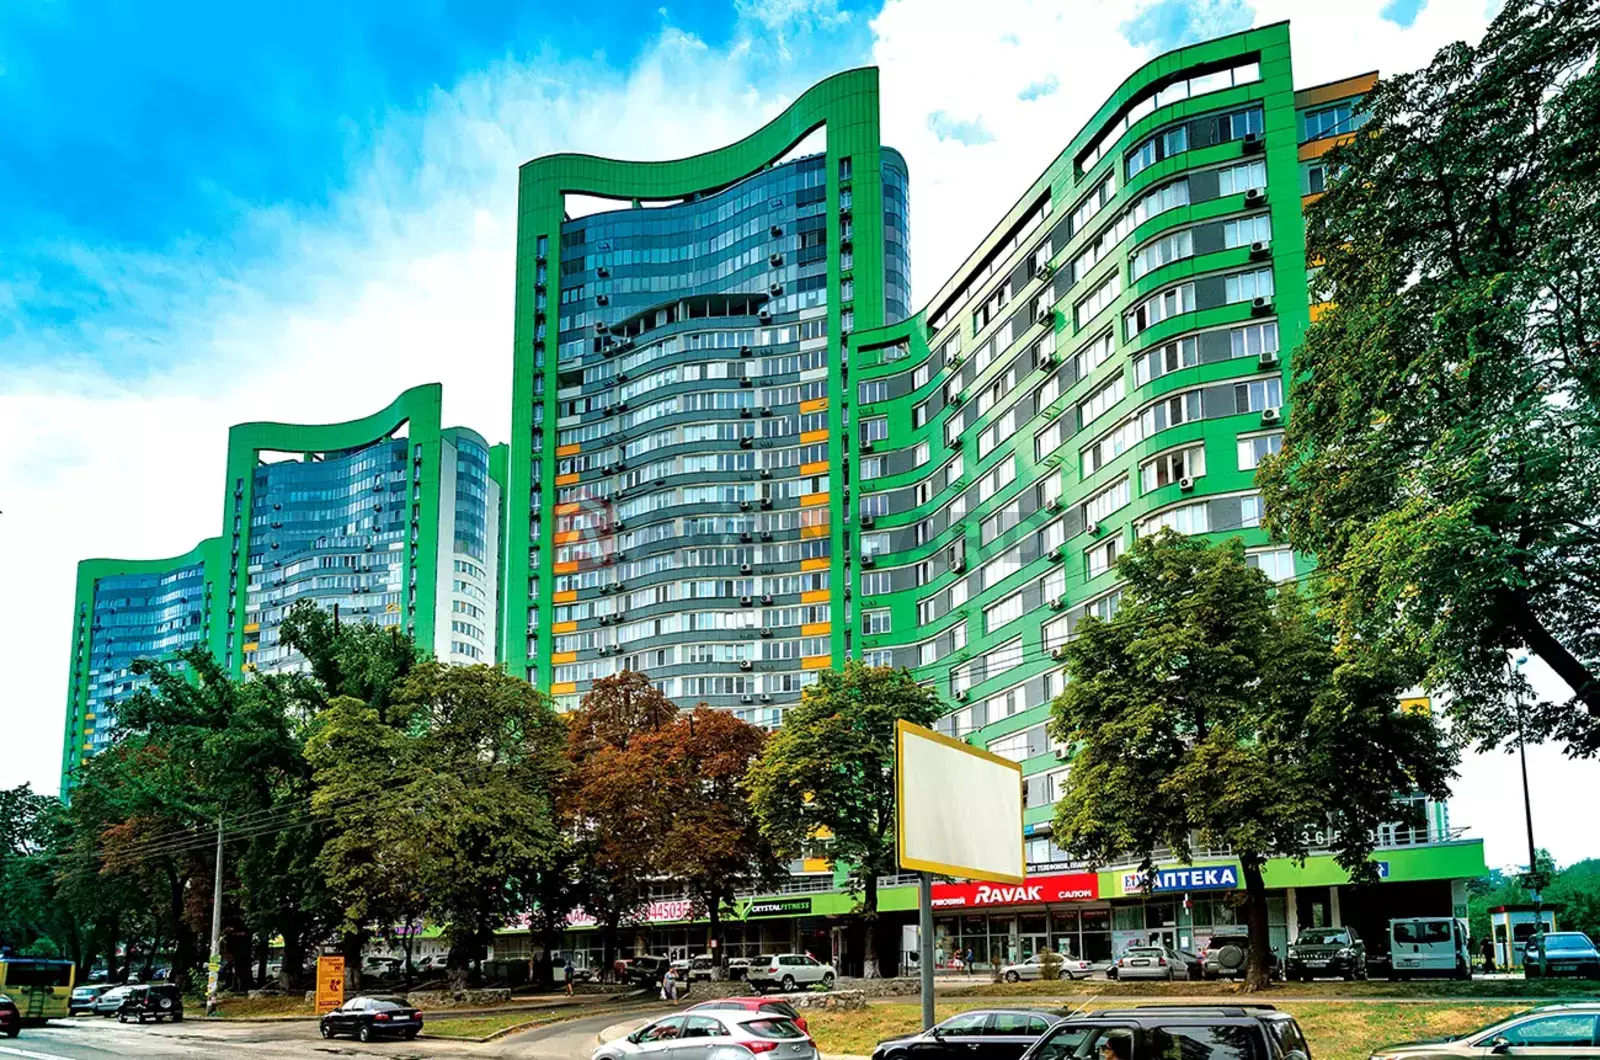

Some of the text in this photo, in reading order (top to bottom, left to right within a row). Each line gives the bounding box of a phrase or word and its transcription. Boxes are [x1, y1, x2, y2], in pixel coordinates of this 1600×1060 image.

[1152, 868, 1236, 889] АПТЕКА
[975, 885, 1042, 904] RAVAK
[1058, 889, 1092, 900] САЛОН
